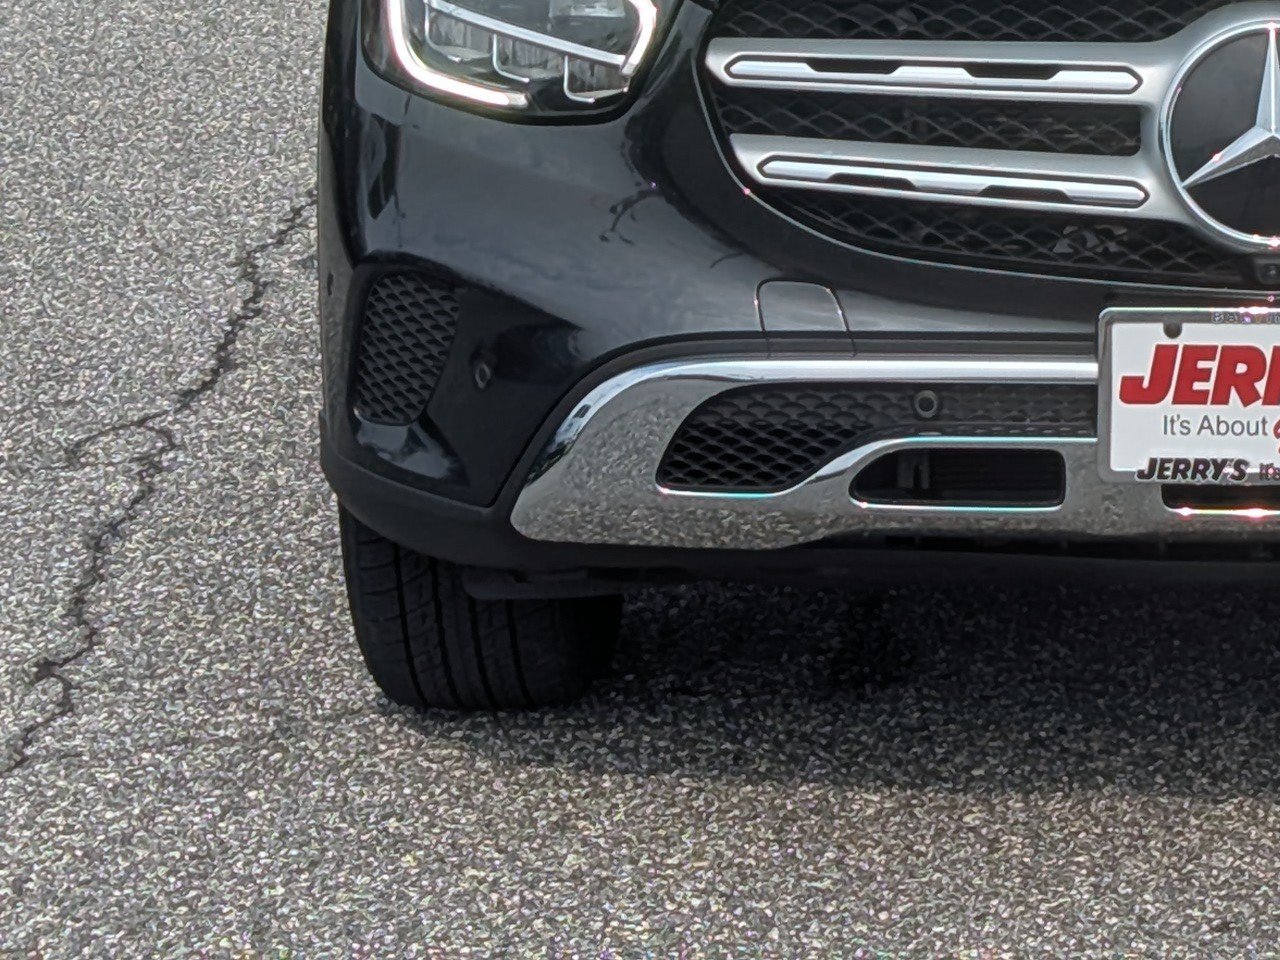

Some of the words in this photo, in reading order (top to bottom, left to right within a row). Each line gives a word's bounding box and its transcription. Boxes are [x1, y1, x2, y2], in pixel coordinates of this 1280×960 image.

[1162, 414, 1192, 436] It's
[1197, 414, 1268, 437] About
[1136, 456, 1251, 482] JERRY'S
